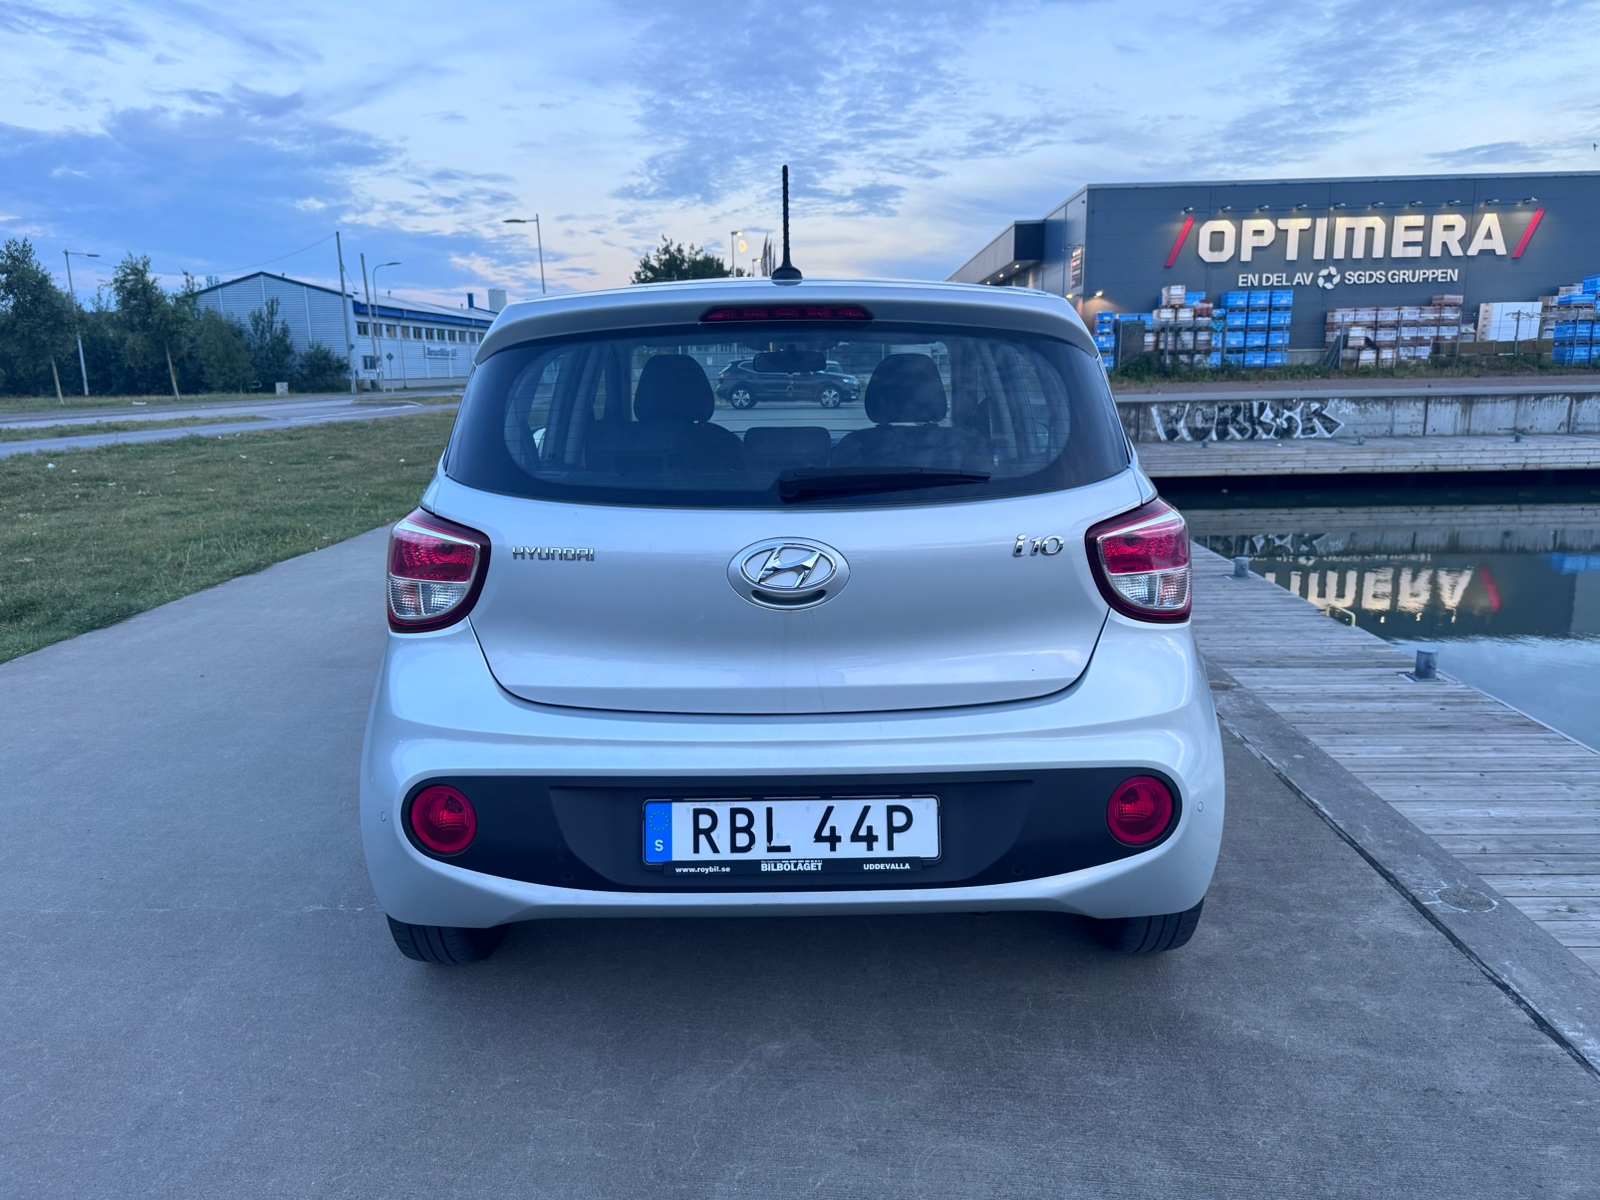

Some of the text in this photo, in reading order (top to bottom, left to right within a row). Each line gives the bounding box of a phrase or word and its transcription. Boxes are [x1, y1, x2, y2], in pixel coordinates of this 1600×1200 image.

[1198, 213, 1507, 263] OPTIMERA
[1238, 268, 1459, 287] EN DEL AV SGDS GRUPPEN
[512, 546, 595, 561] HYUNDAI
[1012, 534, 1065, 557] i10
[693, 804, 913, 854] RBL 44P
[655, 839, 664, 852] S
[675, 866, 731, 874] www.roybil.se
[761, 863, 822, 872] BILBOLAGET
